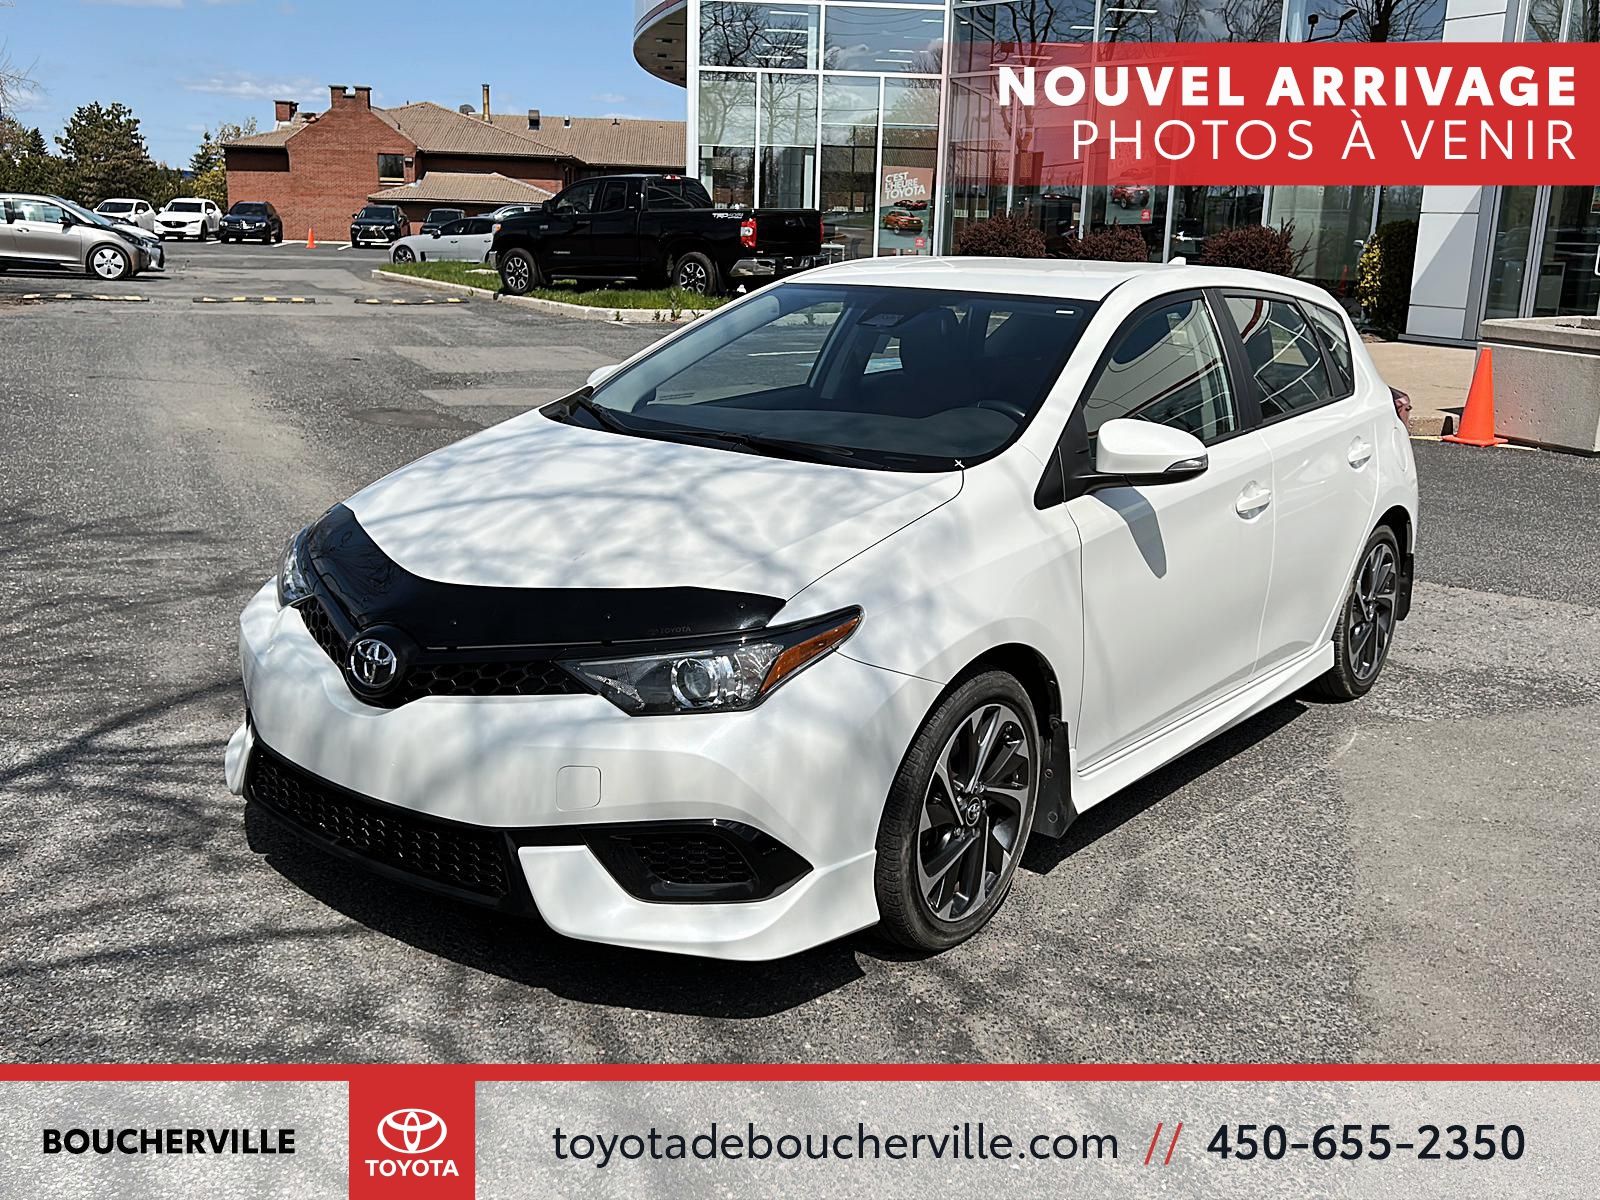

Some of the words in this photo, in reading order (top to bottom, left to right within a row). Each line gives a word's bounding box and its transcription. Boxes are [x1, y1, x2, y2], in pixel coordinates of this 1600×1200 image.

[884, 178, 919, 192] L'HEURE
[885, 185, 926, 200] TOYOTA
[660, 626, 692, 635] TOYOTA
